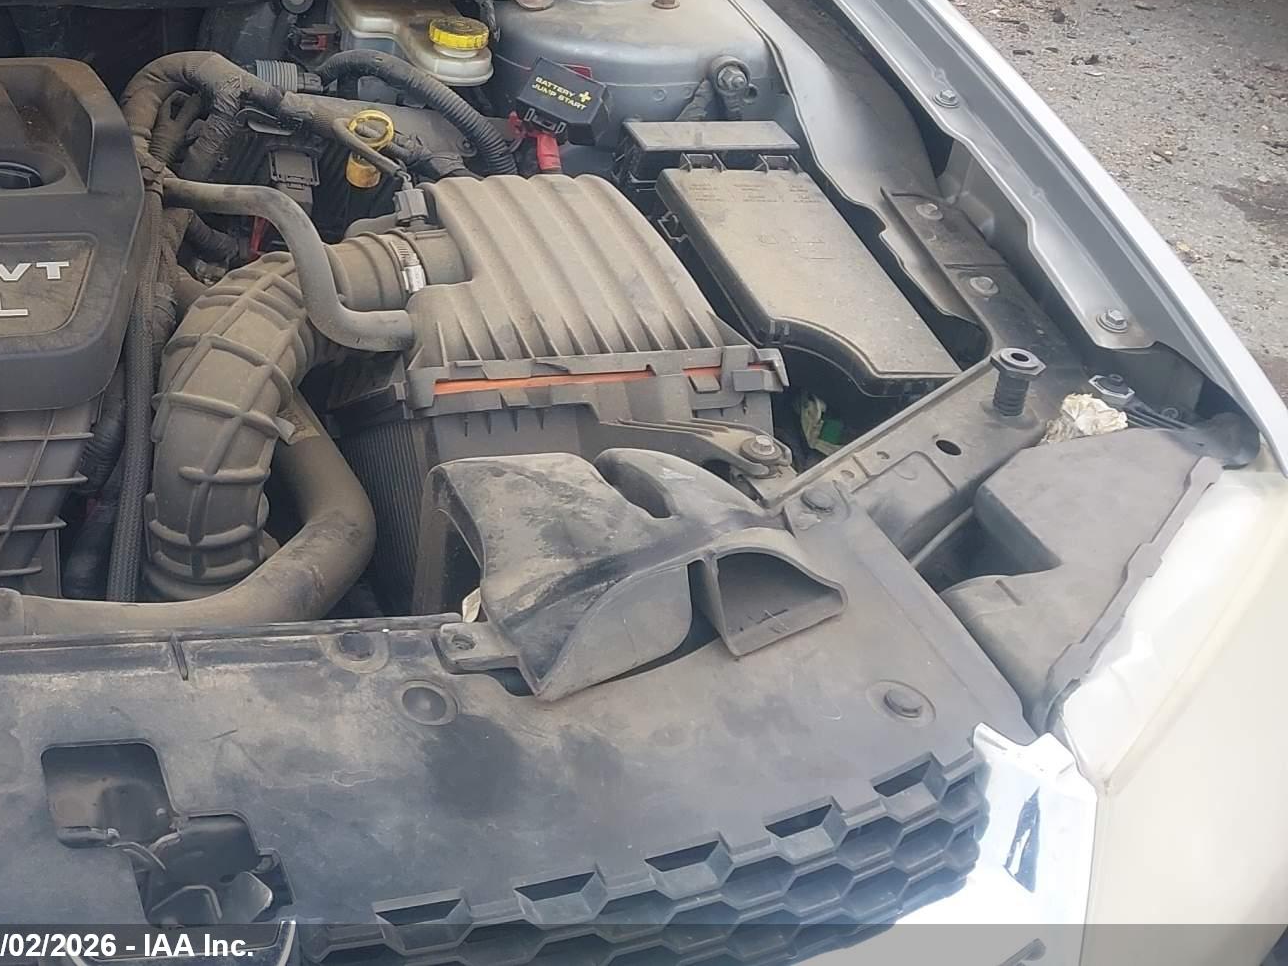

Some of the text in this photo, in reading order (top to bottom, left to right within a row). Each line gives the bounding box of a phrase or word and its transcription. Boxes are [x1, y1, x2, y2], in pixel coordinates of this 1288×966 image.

[532, 83, 588, 111] JUMP START
[535, 76, 575, 97] BATTERY
